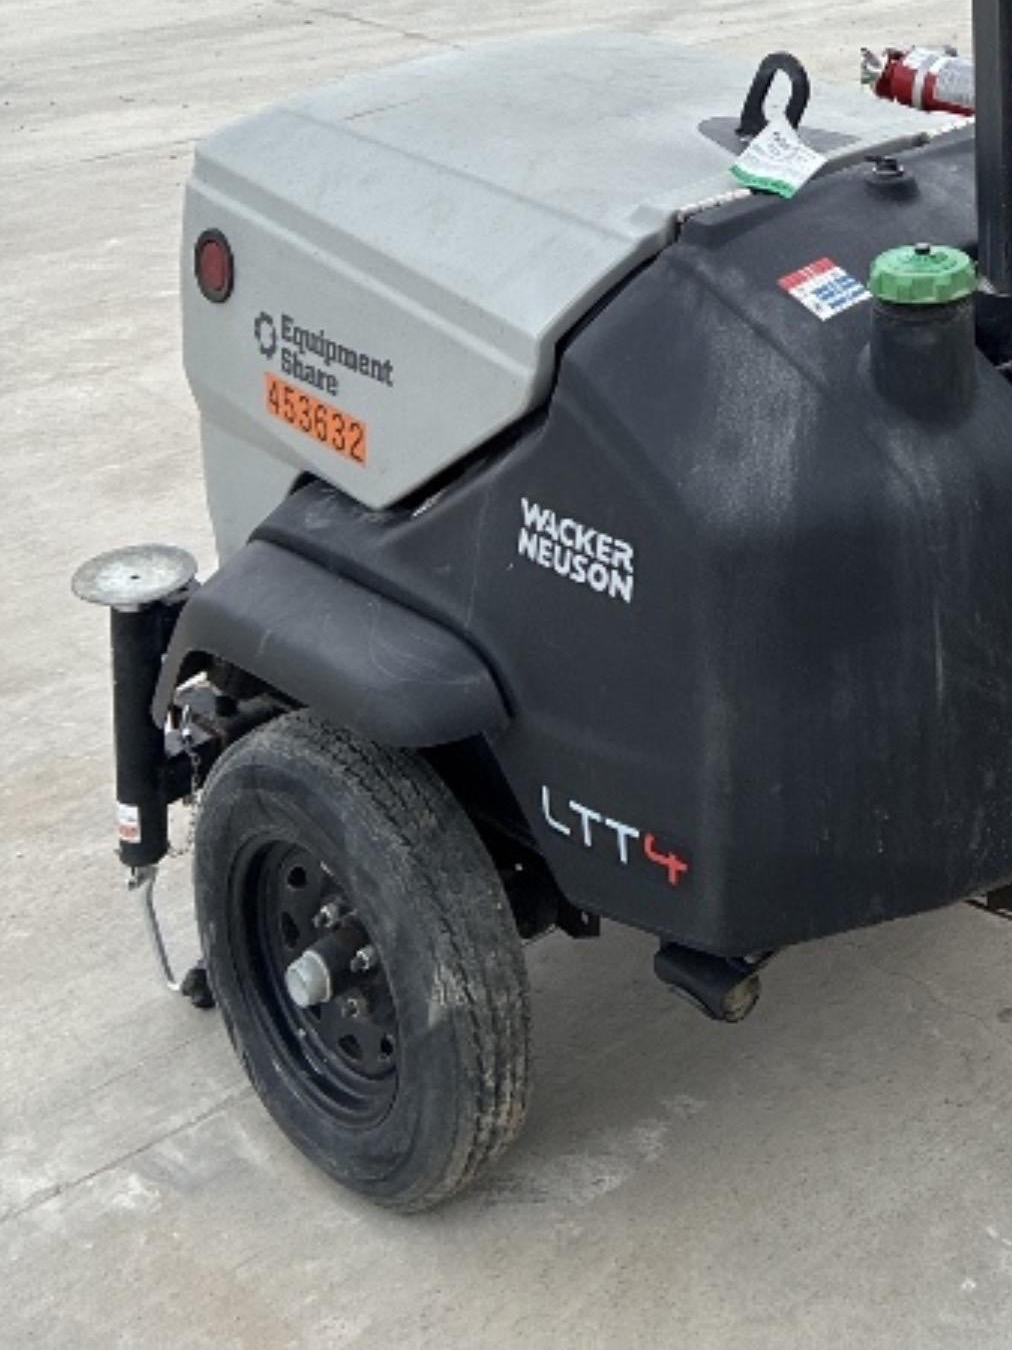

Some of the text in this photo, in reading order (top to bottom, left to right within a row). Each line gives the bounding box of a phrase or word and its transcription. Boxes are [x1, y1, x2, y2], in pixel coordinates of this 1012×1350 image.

[280, 314, 394, 388] Equipment
[280, 348, 339, 397] Share
[266, 380, 367, 464] 453632
[518, 527, 634, 603] NEUSON
[520, 497, 634, 572] WACKER
[541, 784, 689, 886] LTT4
